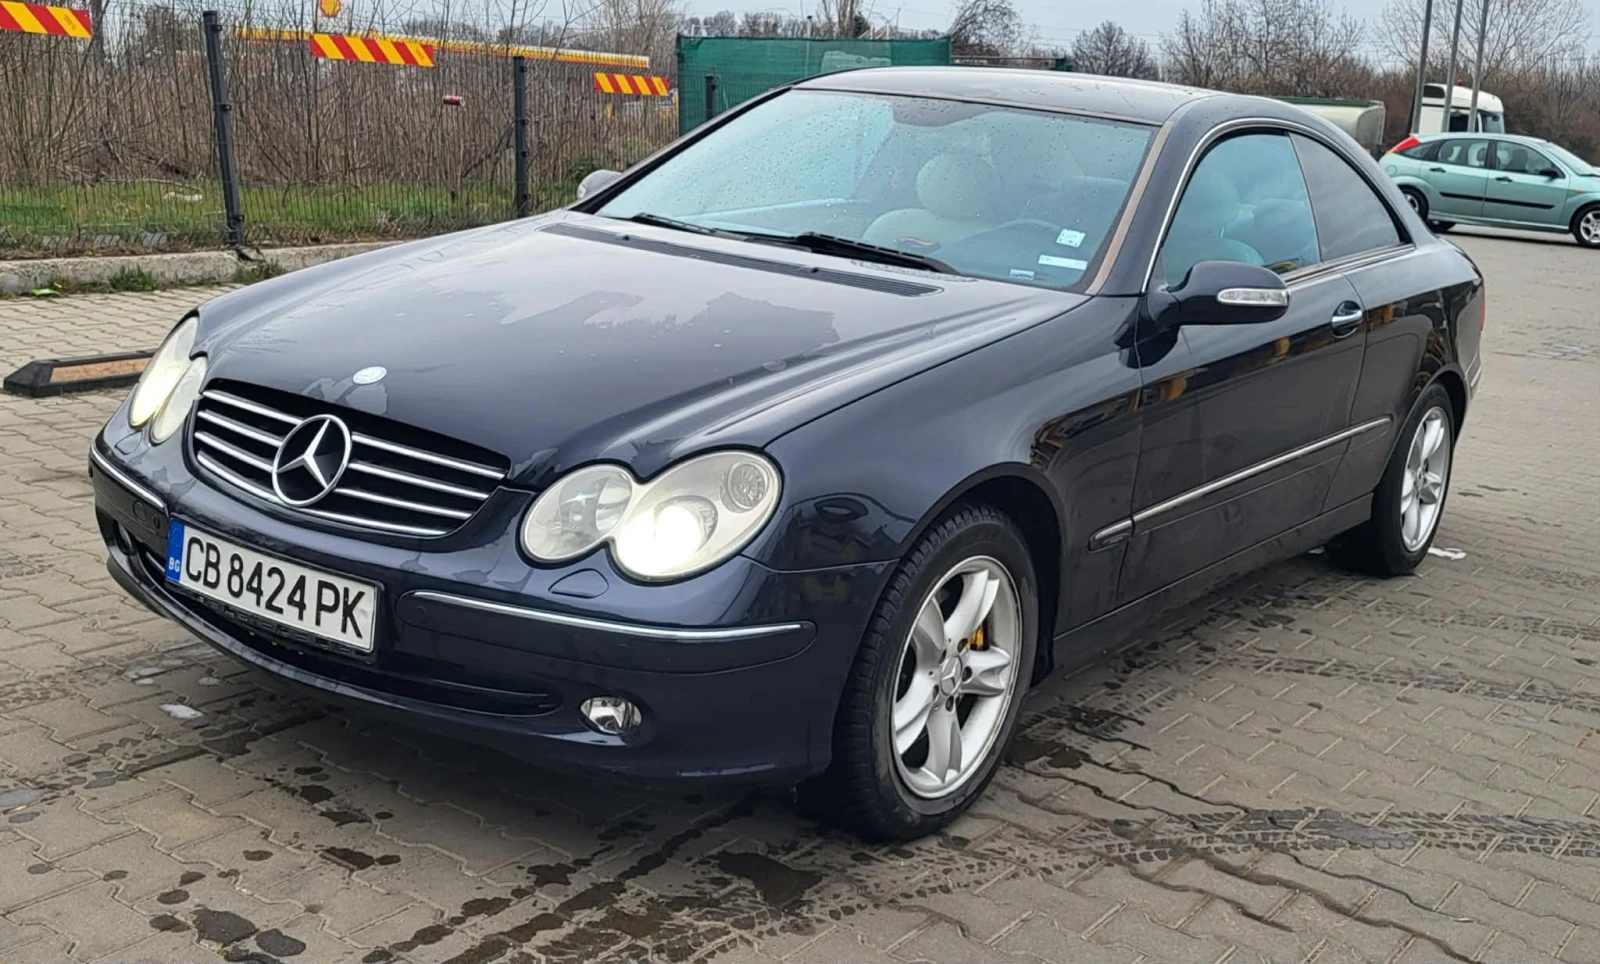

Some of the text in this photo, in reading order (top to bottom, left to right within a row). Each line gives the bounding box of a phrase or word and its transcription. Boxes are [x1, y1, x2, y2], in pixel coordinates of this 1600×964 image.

[168, 557, 181, 573] BG
[185, 536, 366, 640] CB 8424 PK
